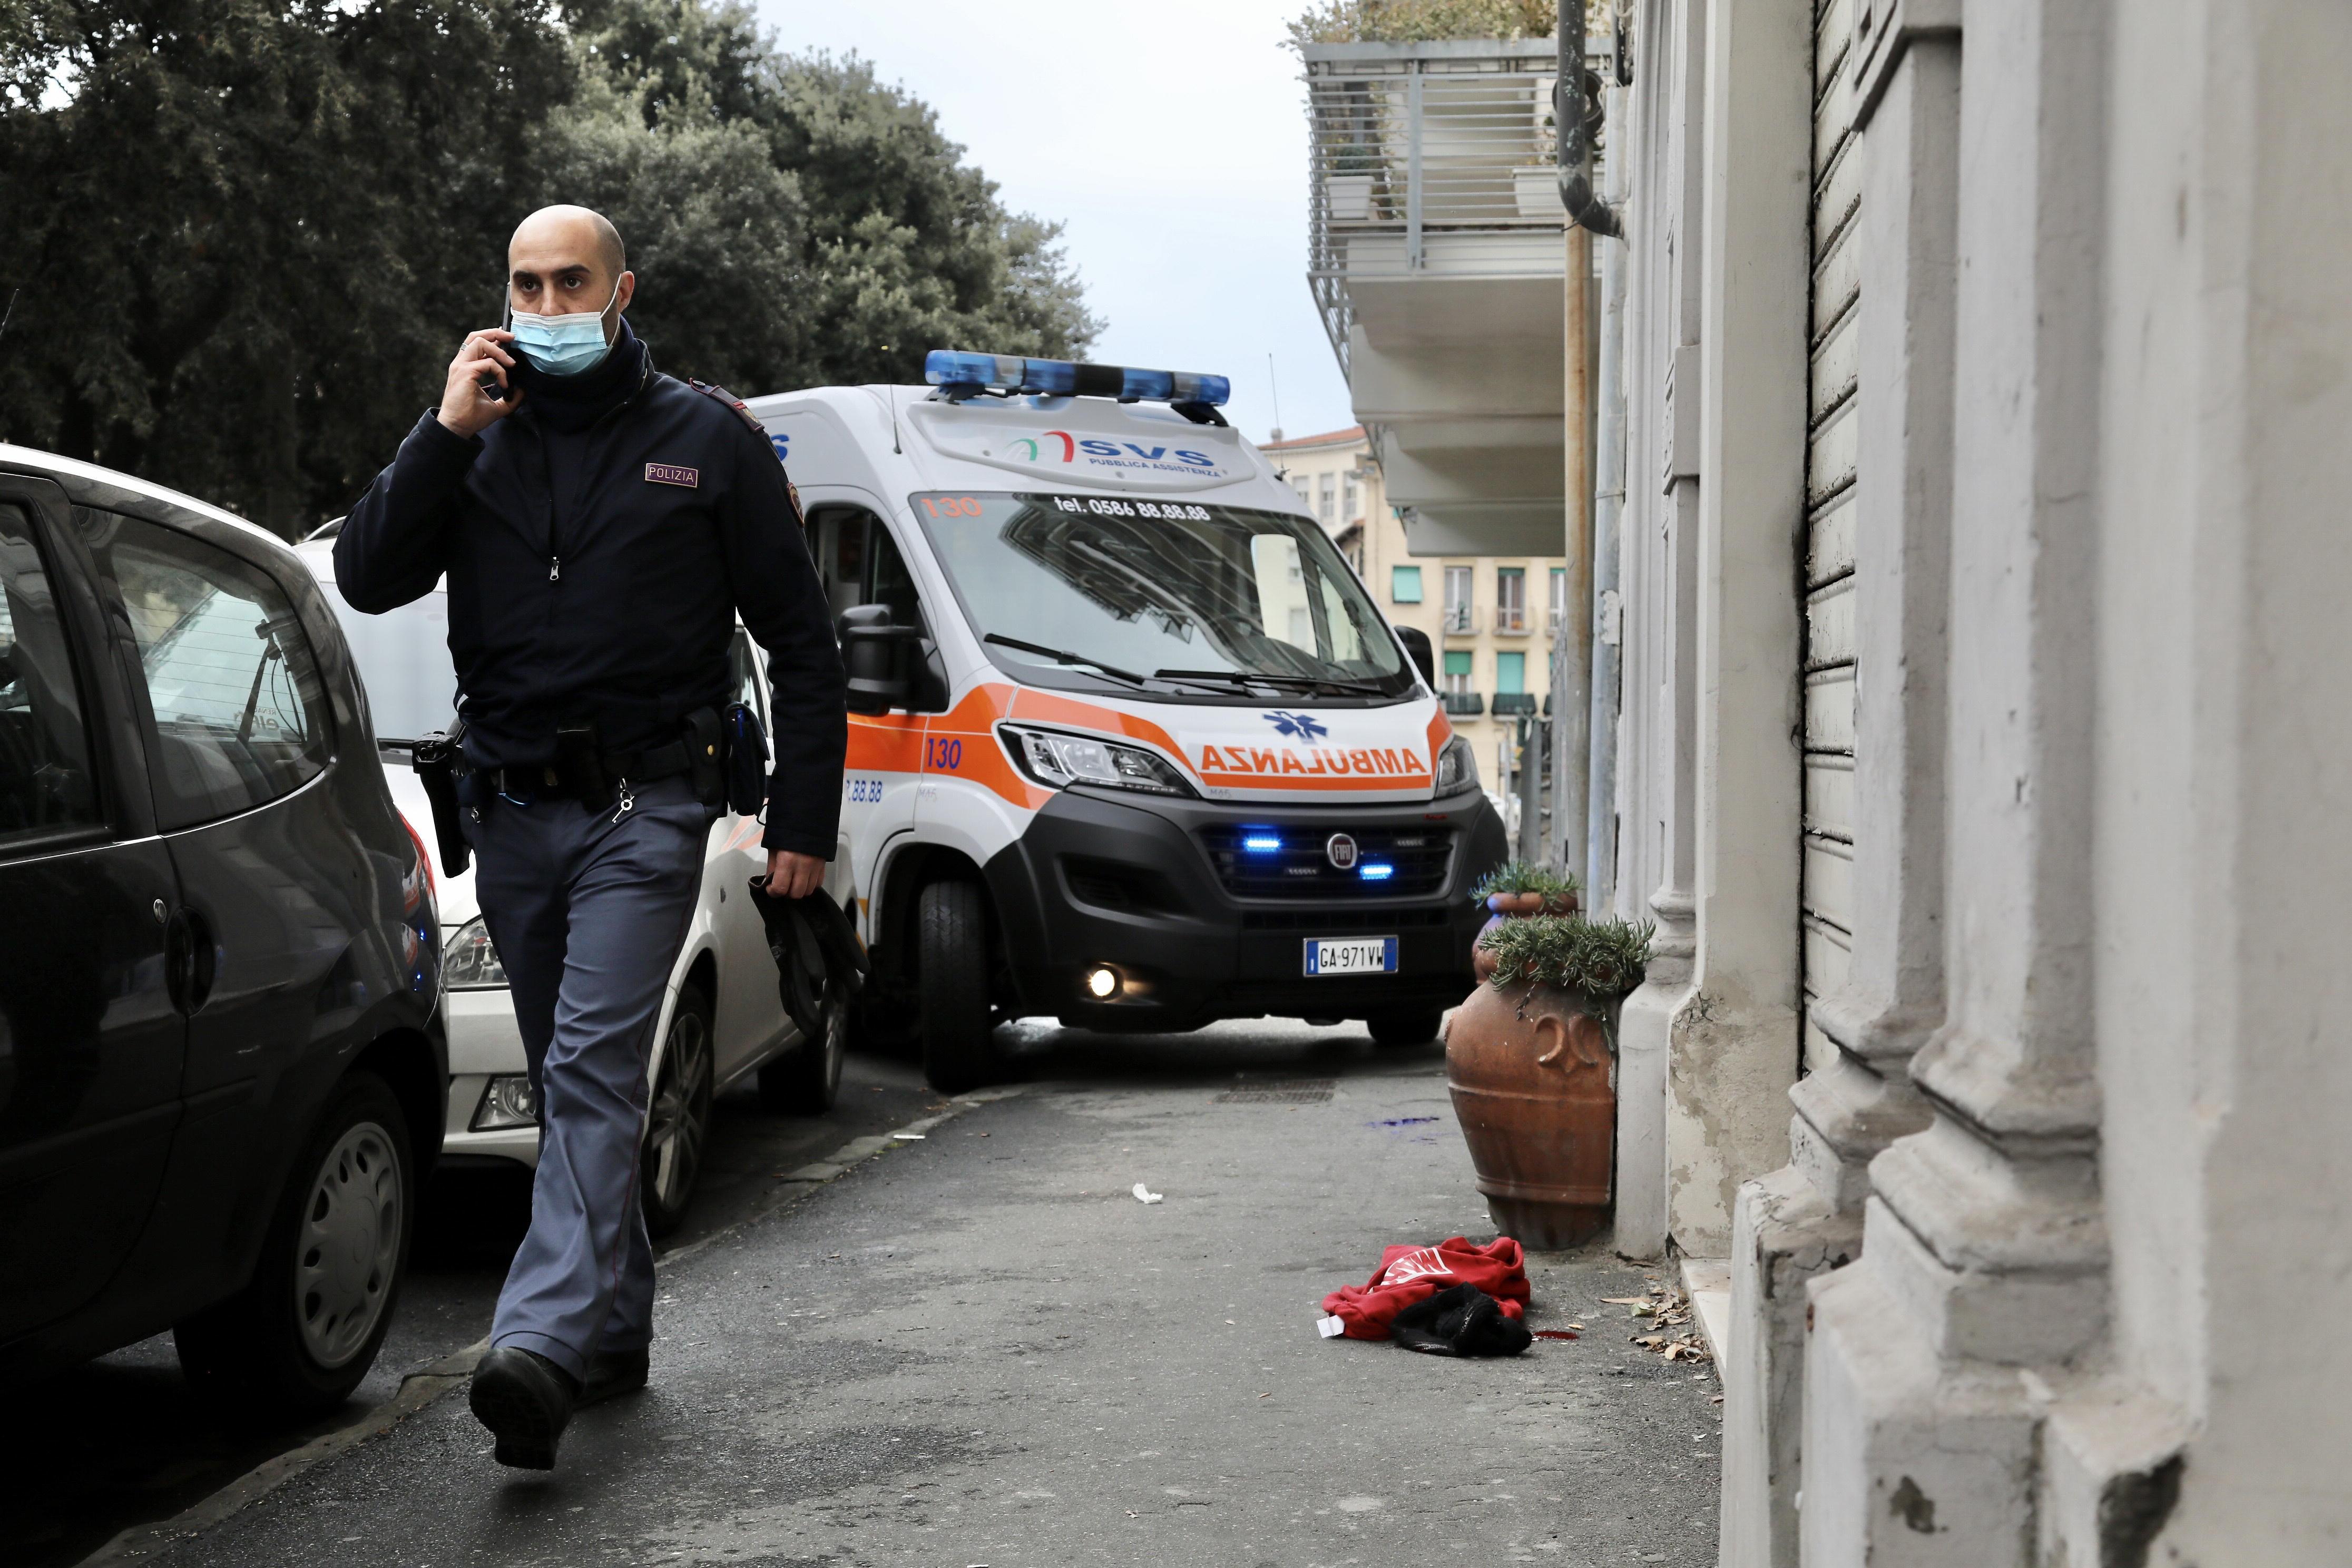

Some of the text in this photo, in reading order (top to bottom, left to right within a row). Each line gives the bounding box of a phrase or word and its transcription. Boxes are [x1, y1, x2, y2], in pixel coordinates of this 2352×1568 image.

[1079, 439, 1214, 466] SVS
[649, 467, 694, 483] POLIZIA
[1089, 458, 1221, 477] PUBBLICA ASSISTENZA
[919, 497, 982, 518] 130
[1054, 496, 1211, 521] tel. 0586 88.88.88
[928, 738, 962, 770] 130
[1334, 845, 1351, 860] FIAT
